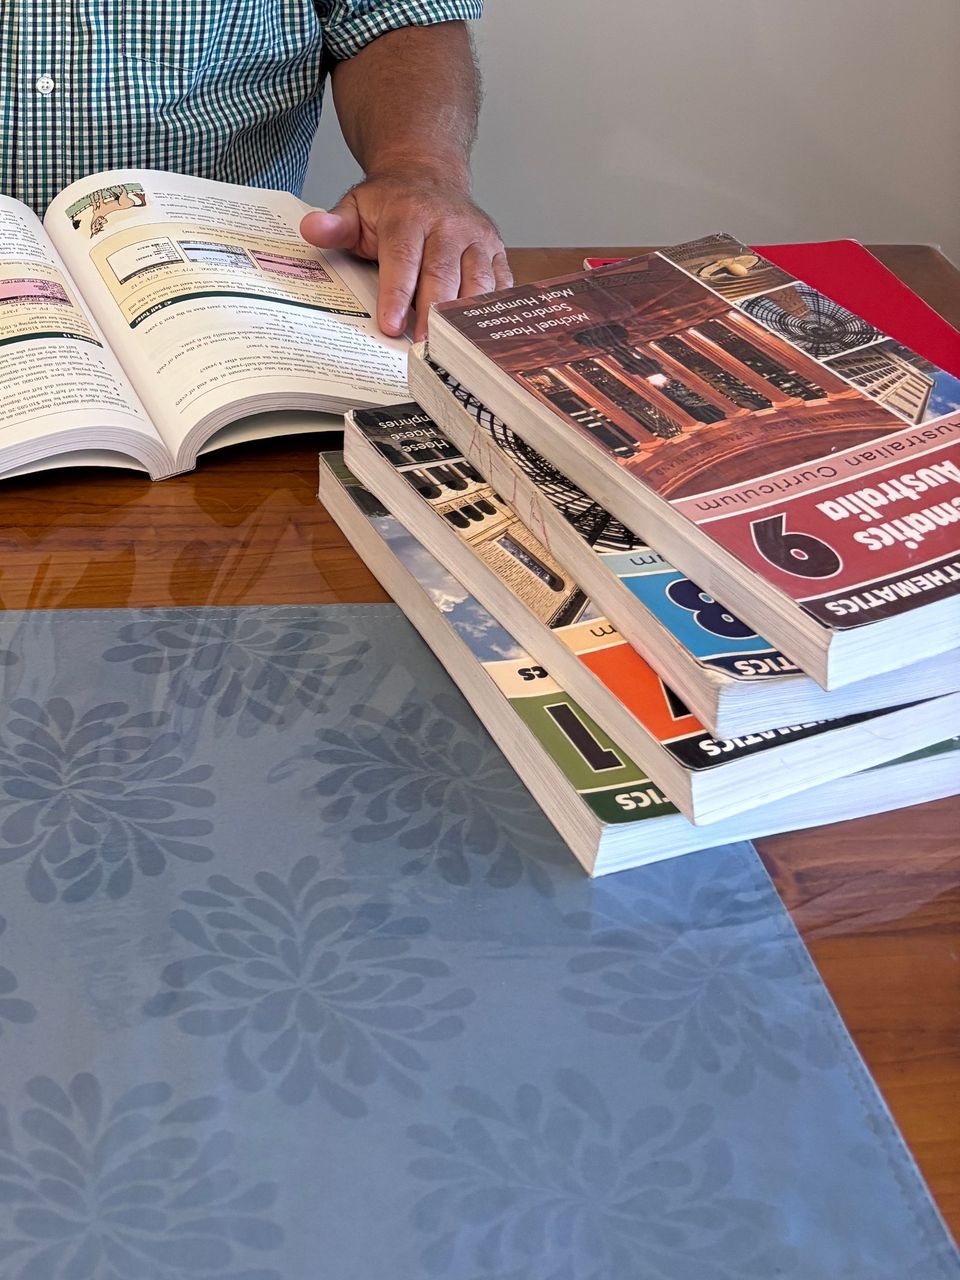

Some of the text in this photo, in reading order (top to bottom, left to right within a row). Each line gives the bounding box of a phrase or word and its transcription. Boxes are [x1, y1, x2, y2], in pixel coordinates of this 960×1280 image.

[462, 287, 574, 316] Mark Humphries
[476, 302, 572, 328] Sandra Haese
[489, 311, 589, 338] Michael Haese
[390, 427, 437, 440] Haese
[400, 439, 449, 453] Haese
[693, 464, 837, 513] Curriculum
[814, 459, 959, 523] Australia
[747, 511, 842, 579] 9
[664, 577, 757, 640] 8
[543, 700, 625, 773] 1
